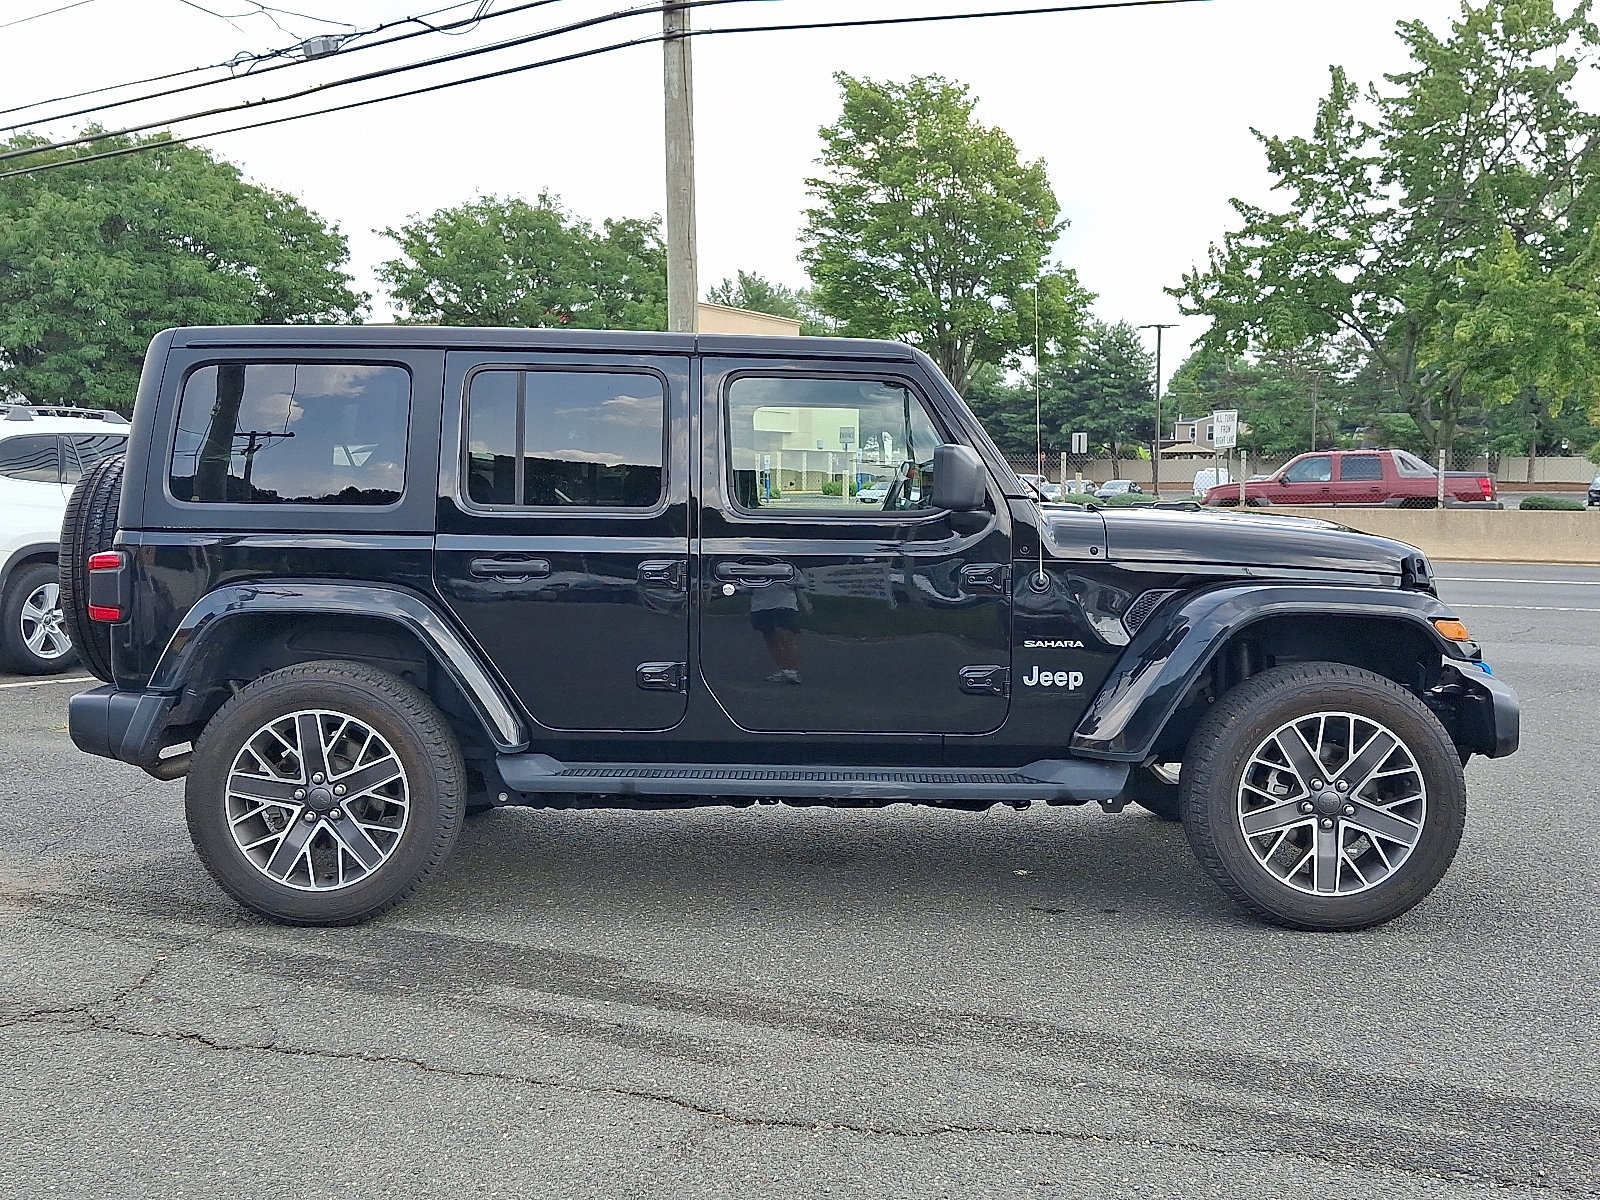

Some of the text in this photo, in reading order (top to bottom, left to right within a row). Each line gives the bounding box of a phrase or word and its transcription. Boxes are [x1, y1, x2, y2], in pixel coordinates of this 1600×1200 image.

[1221, 425, 1231, 434] FROM
[1216, 436, 1226, 445] RIGHT
[1023, 640, 1084, 648] SAHARA
[1023, 666, 1084, 690] Jeep
